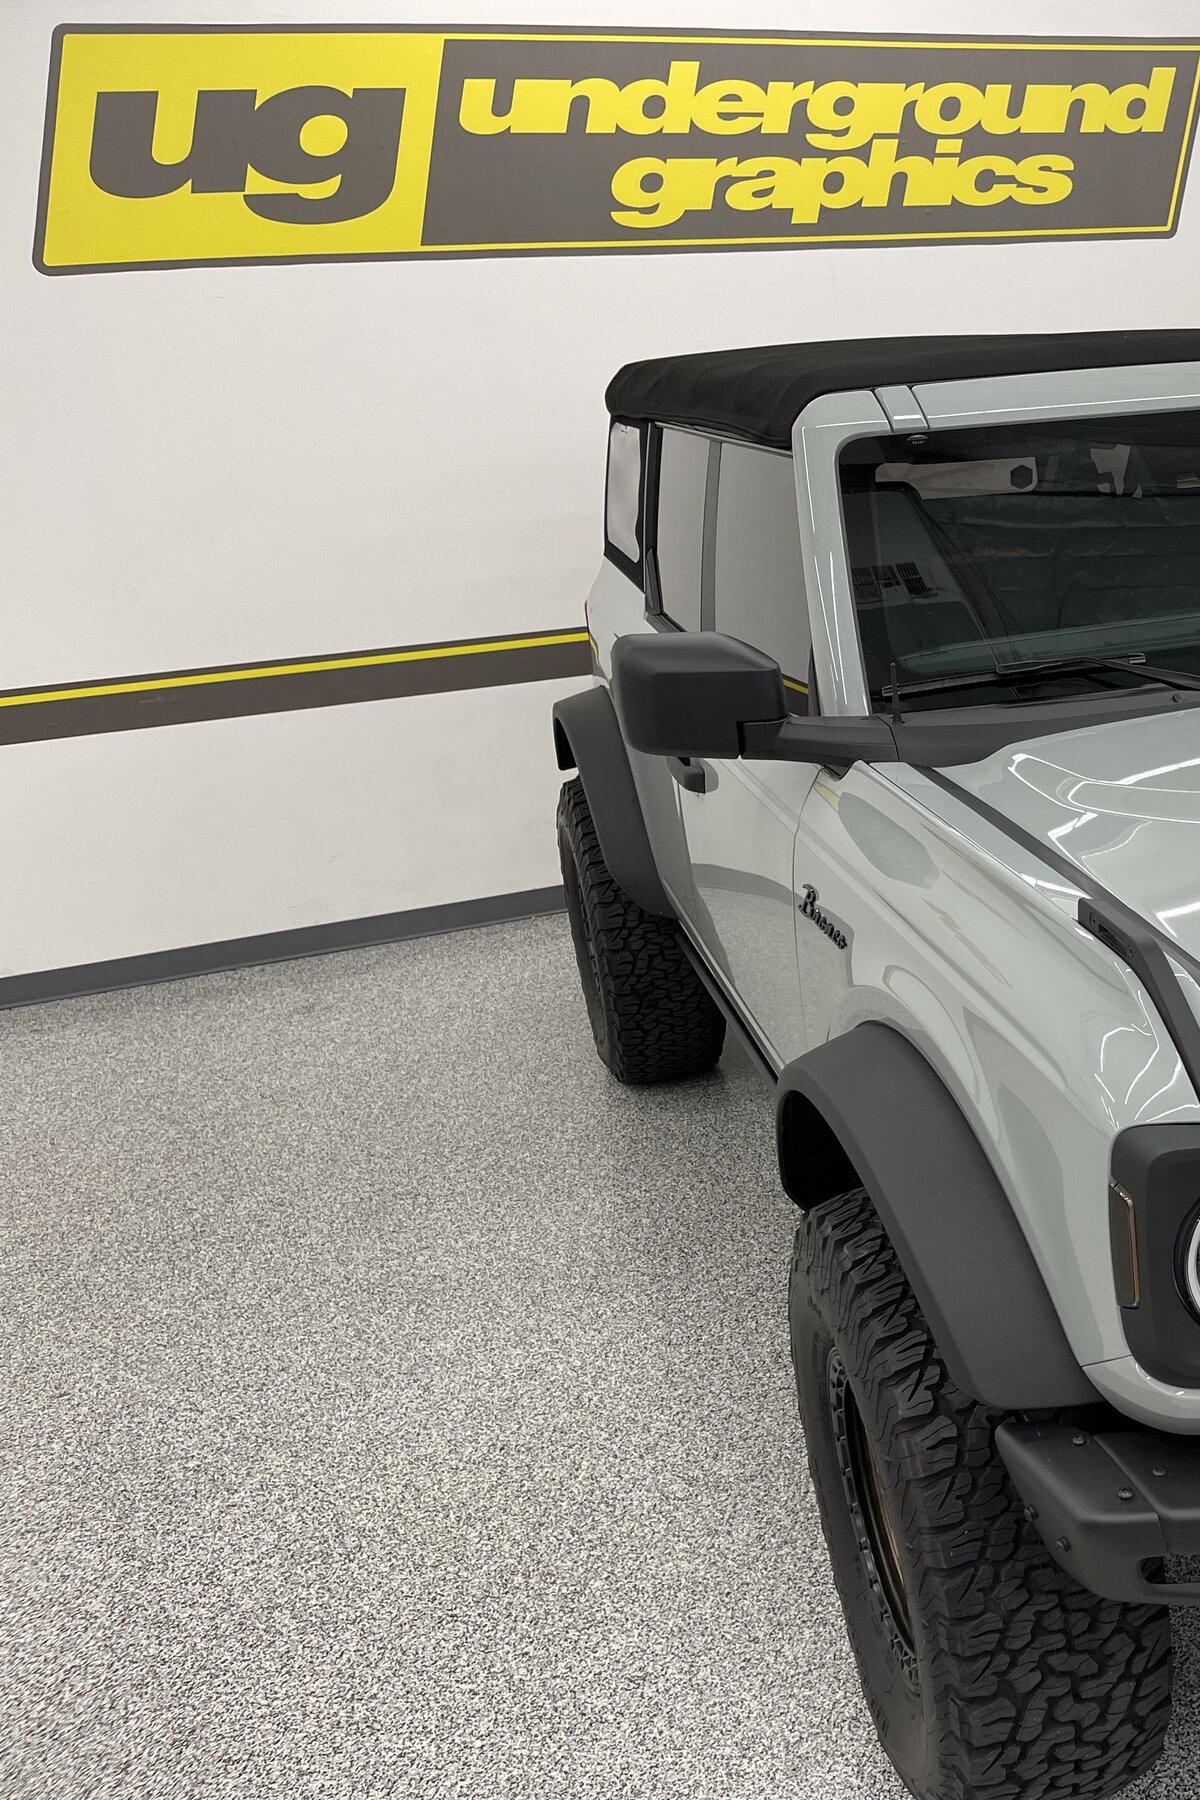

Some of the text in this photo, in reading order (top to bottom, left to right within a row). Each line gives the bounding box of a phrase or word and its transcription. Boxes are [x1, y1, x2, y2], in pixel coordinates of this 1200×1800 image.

[459, 61, 1177, 150] underground
[89, 85, 406, 225] ug
[610, 139, 1074, 228] graphics
